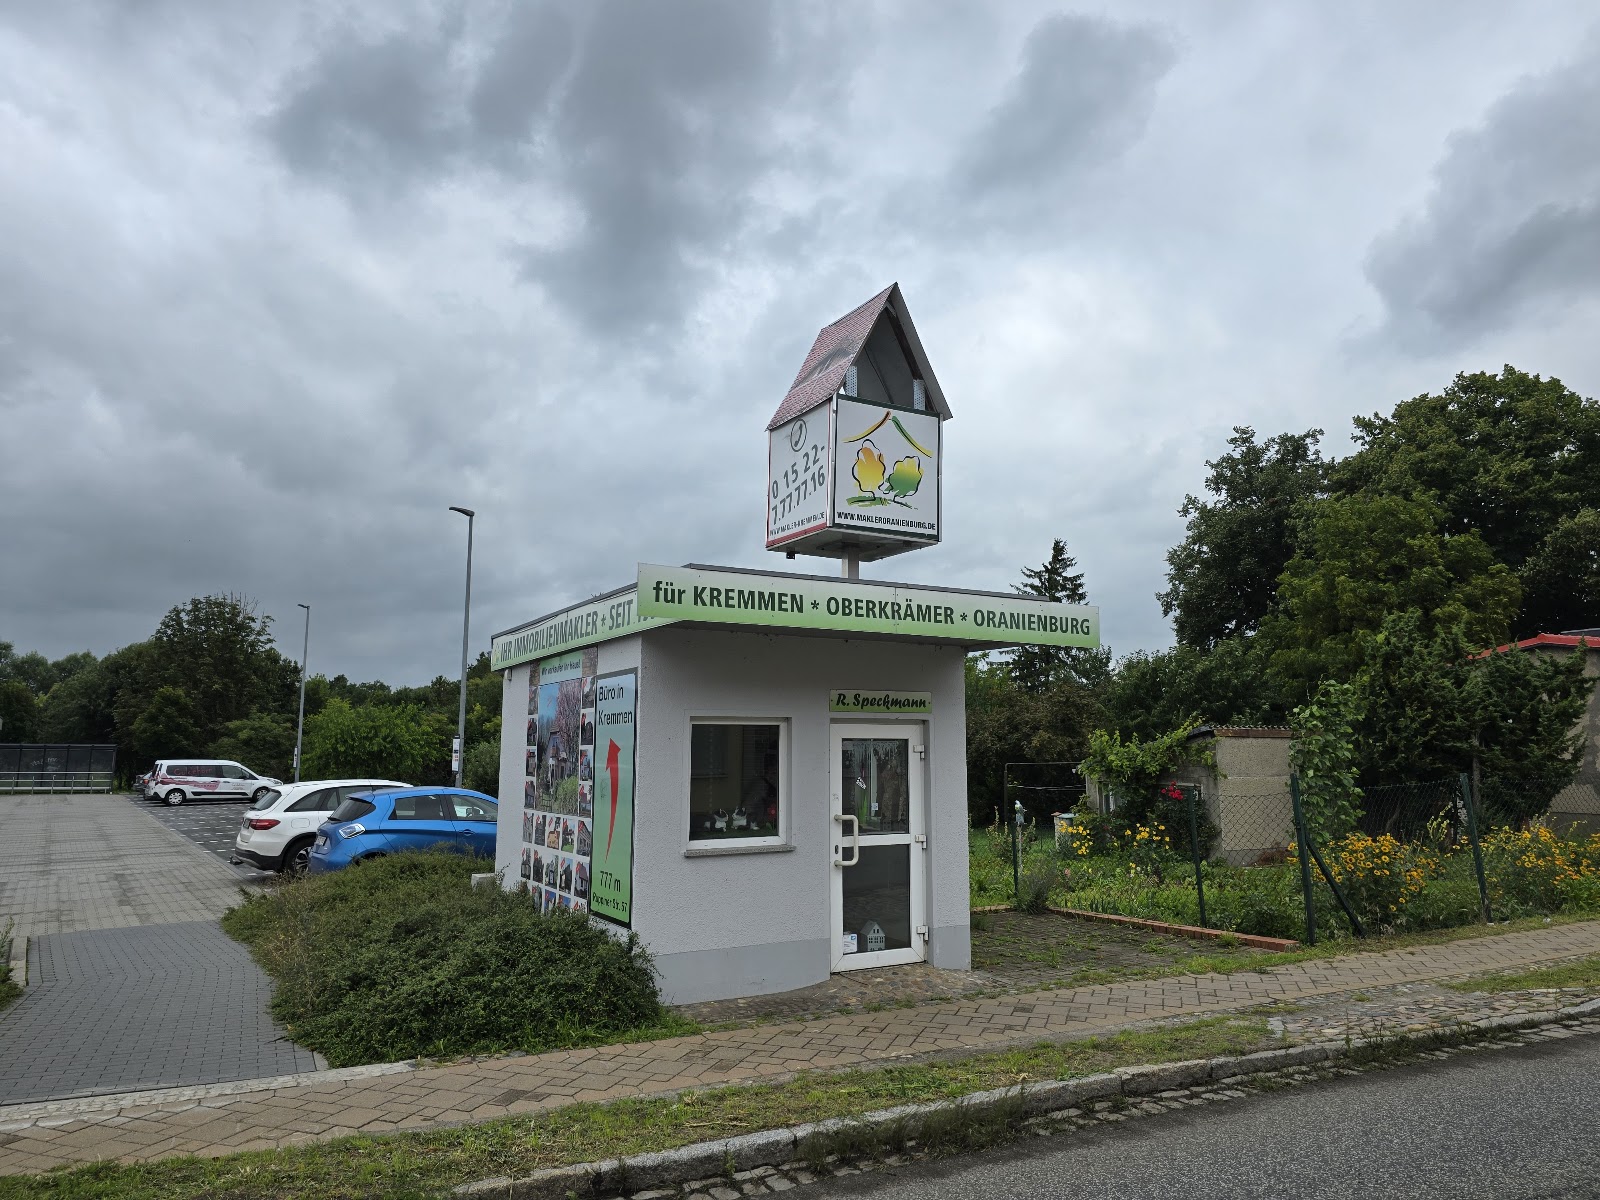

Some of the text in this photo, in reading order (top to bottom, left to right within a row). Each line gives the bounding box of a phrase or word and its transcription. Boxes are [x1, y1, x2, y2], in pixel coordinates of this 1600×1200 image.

[772, 480, 779, 499] 0
[783, 462, 799, 489] 15
[836, 511, 936, 531] WWW.MAKLERORANIENBURG.DE
[652, 580, 1090, 636] für KREMMEN OBERKRÄMER ORANIENBURG
[500, 598, 634, 663] IHR IMMOBILIENMAKLER SEIT
[598, 683, 624, 702] Büro in
[836, 693, 927, 711] R. Speckmann
[598, 710, 633, 726] Kremmen
[600, 871, 620, 892] 777 m
